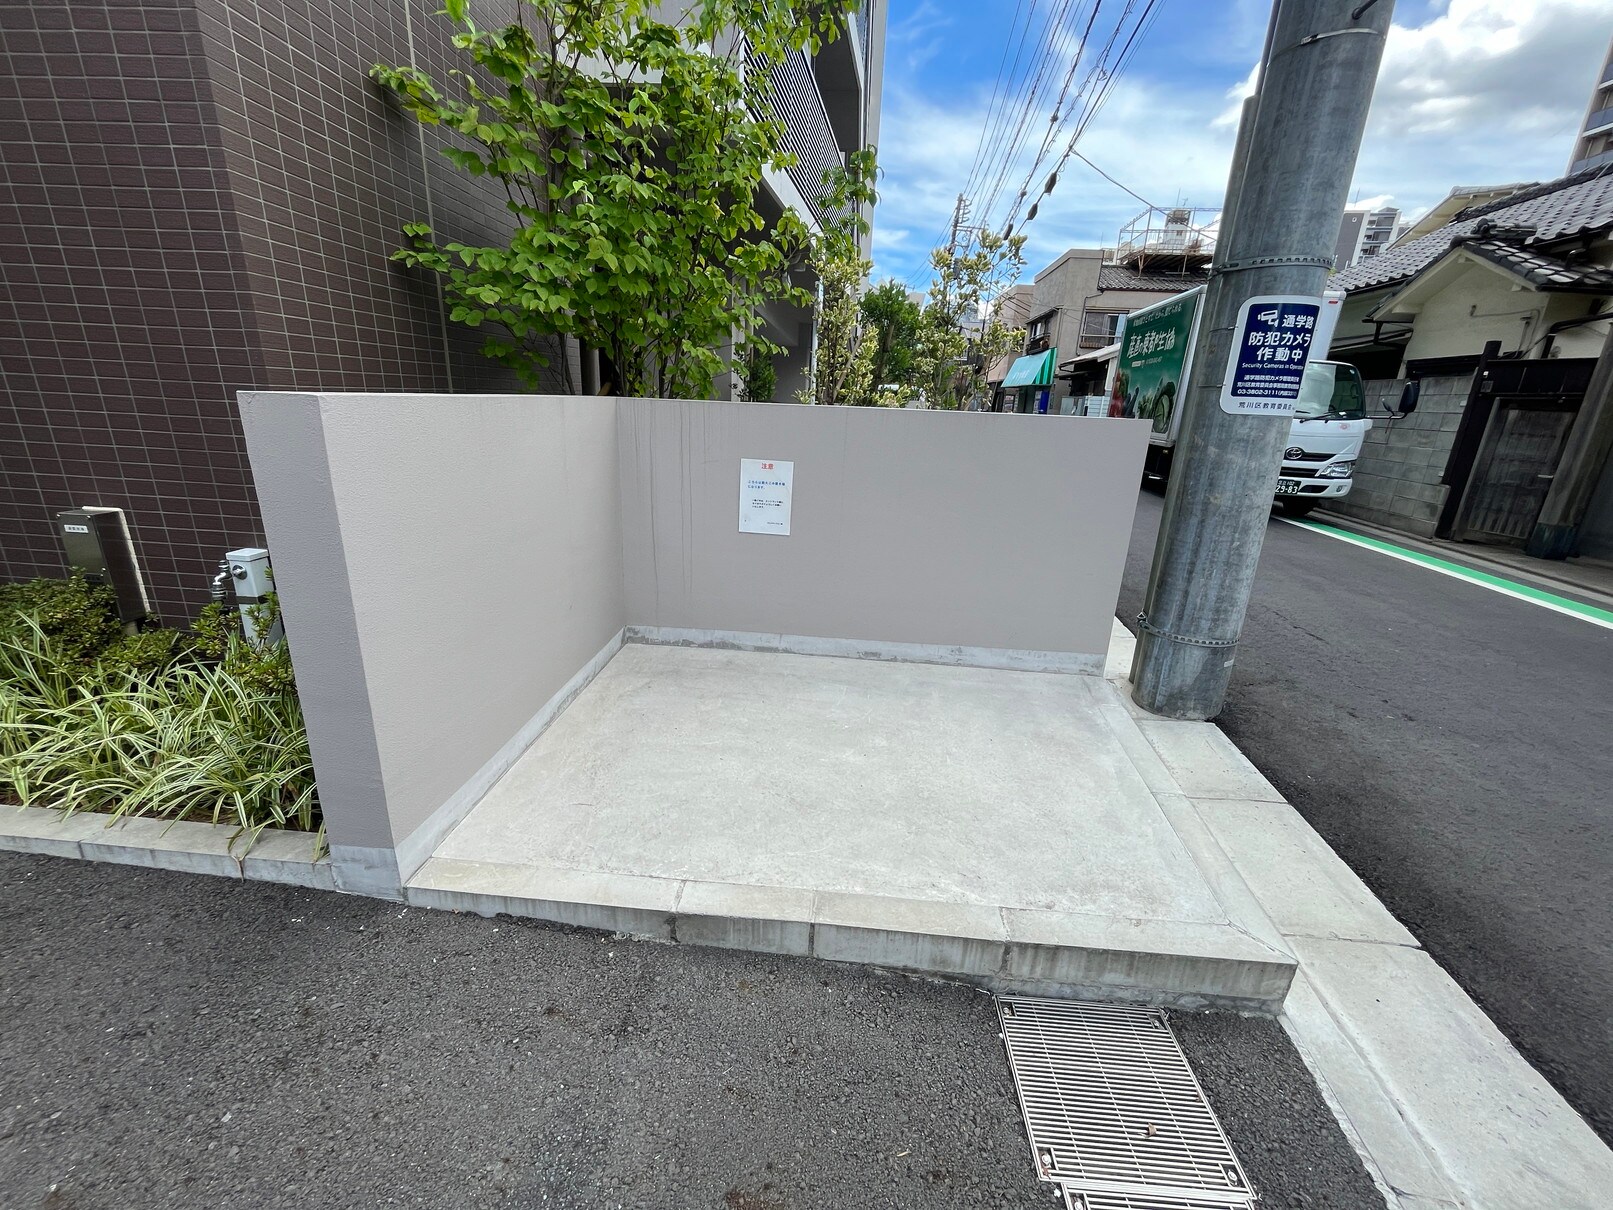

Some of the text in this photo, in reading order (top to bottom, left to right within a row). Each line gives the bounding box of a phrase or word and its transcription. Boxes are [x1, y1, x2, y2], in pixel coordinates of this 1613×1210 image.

[1281, 314, 1314, 329] 通学路
[1248, 332, 1311, 347] 防犯カメラ
[1256, 347, 1303, 363] 作動中
[1242, 362, 1262, 370] Security
[1238, 401, 1292, 410] 荒川区教育委員会
[761, 462, 774, 470] 注意
[1275, 485, 1298, 494] 29-83
